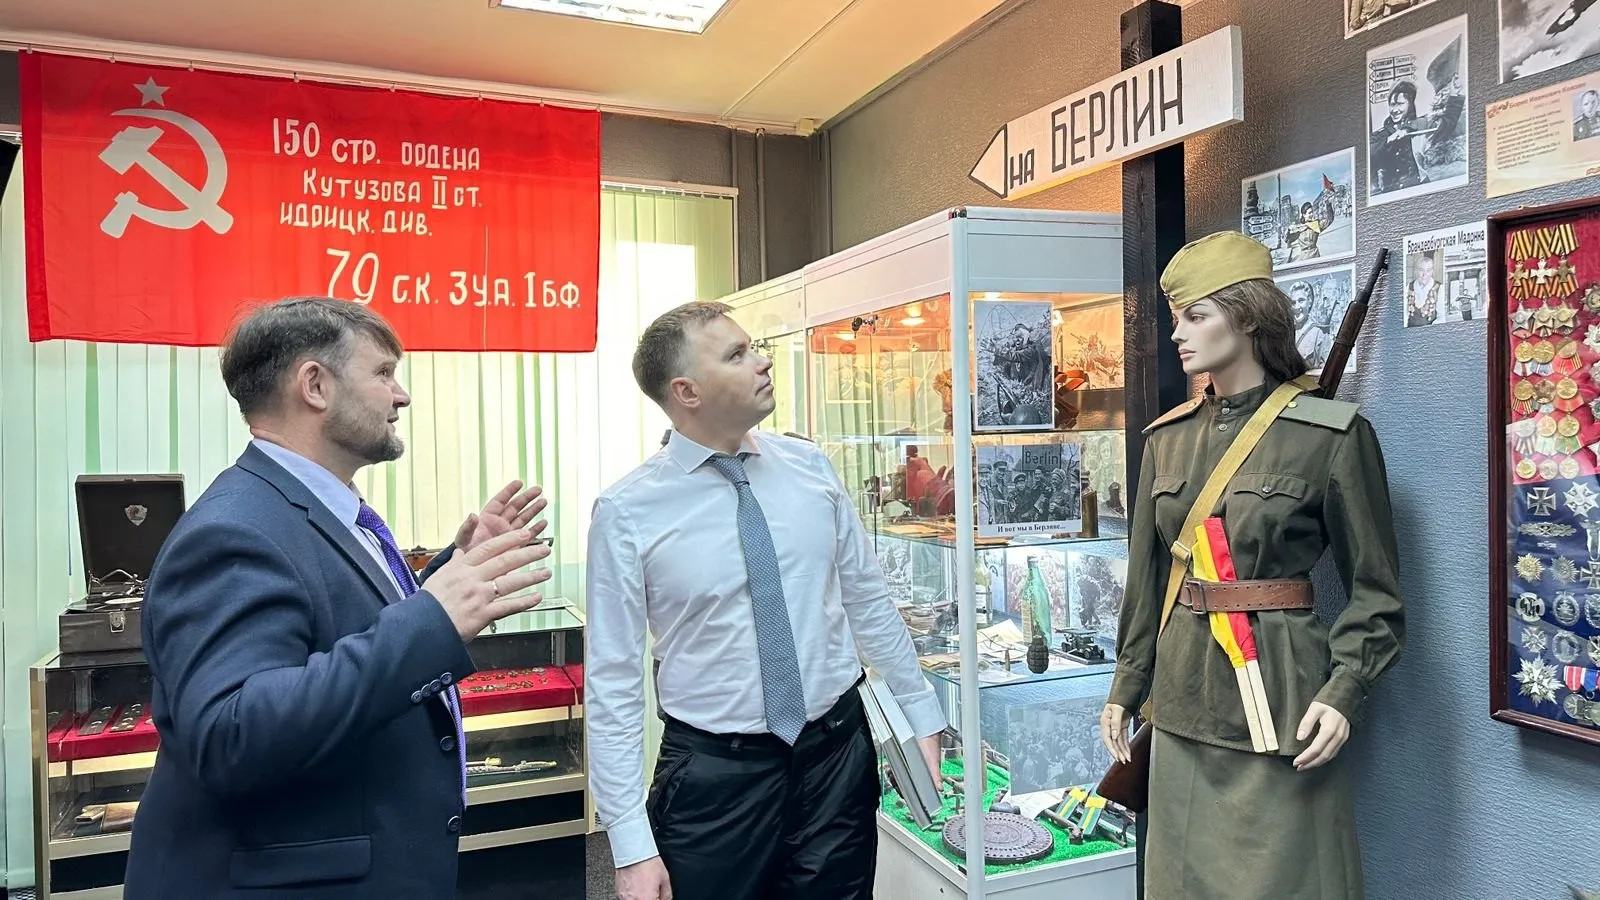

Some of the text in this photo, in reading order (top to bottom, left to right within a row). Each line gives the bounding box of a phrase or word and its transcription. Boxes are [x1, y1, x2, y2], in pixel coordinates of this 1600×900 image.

[1051, 57, 1183, 173] БЕРЛИН
[273, 118, 480, 171] 150 СТР. ОРДЕНА
[280, 202, 432, 236] ИДРИЦК. ДИВ.
[1457, 230, 1485, 246] Мадонна
[327, 248, 379, 304] 79
[1025, 450, 1058, 465] Berlin
